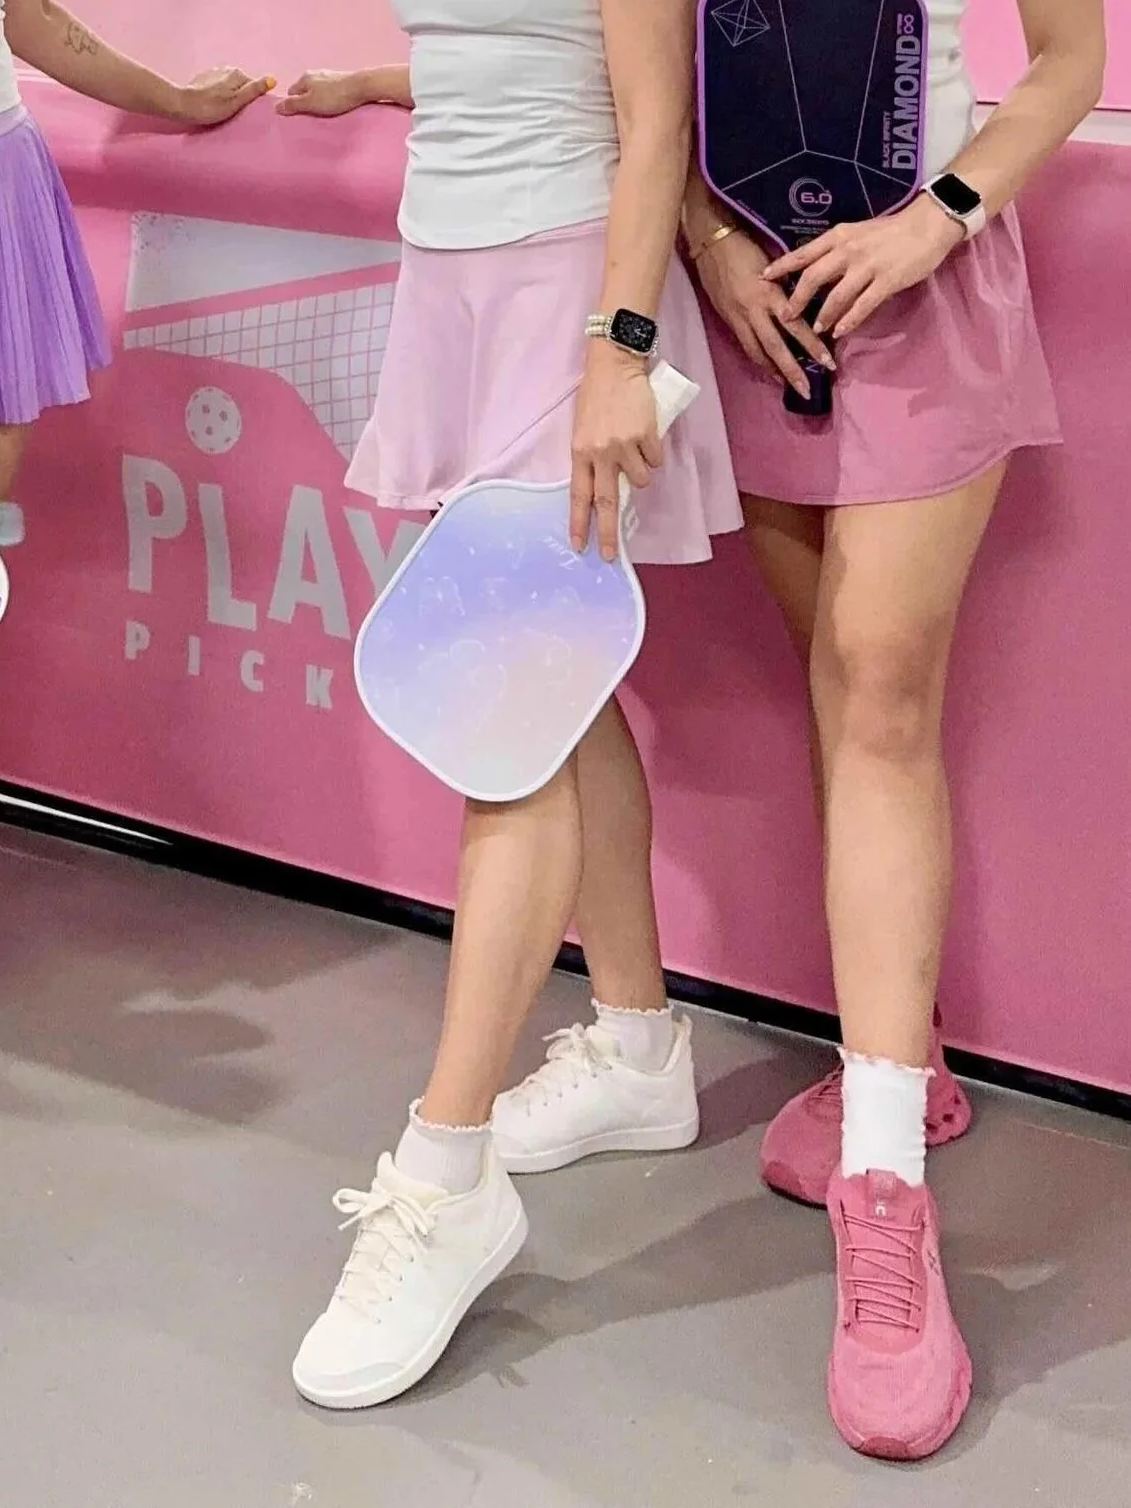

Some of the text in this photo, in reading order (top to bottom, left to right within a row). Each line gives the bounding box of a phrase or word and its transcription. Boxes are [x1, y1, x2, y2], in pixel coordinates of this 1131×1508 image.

[892, 35, 921, 171] DIAMOND
[800, 191, 832, 204] 6.0
[121, 453, 427, 640] PLAY
